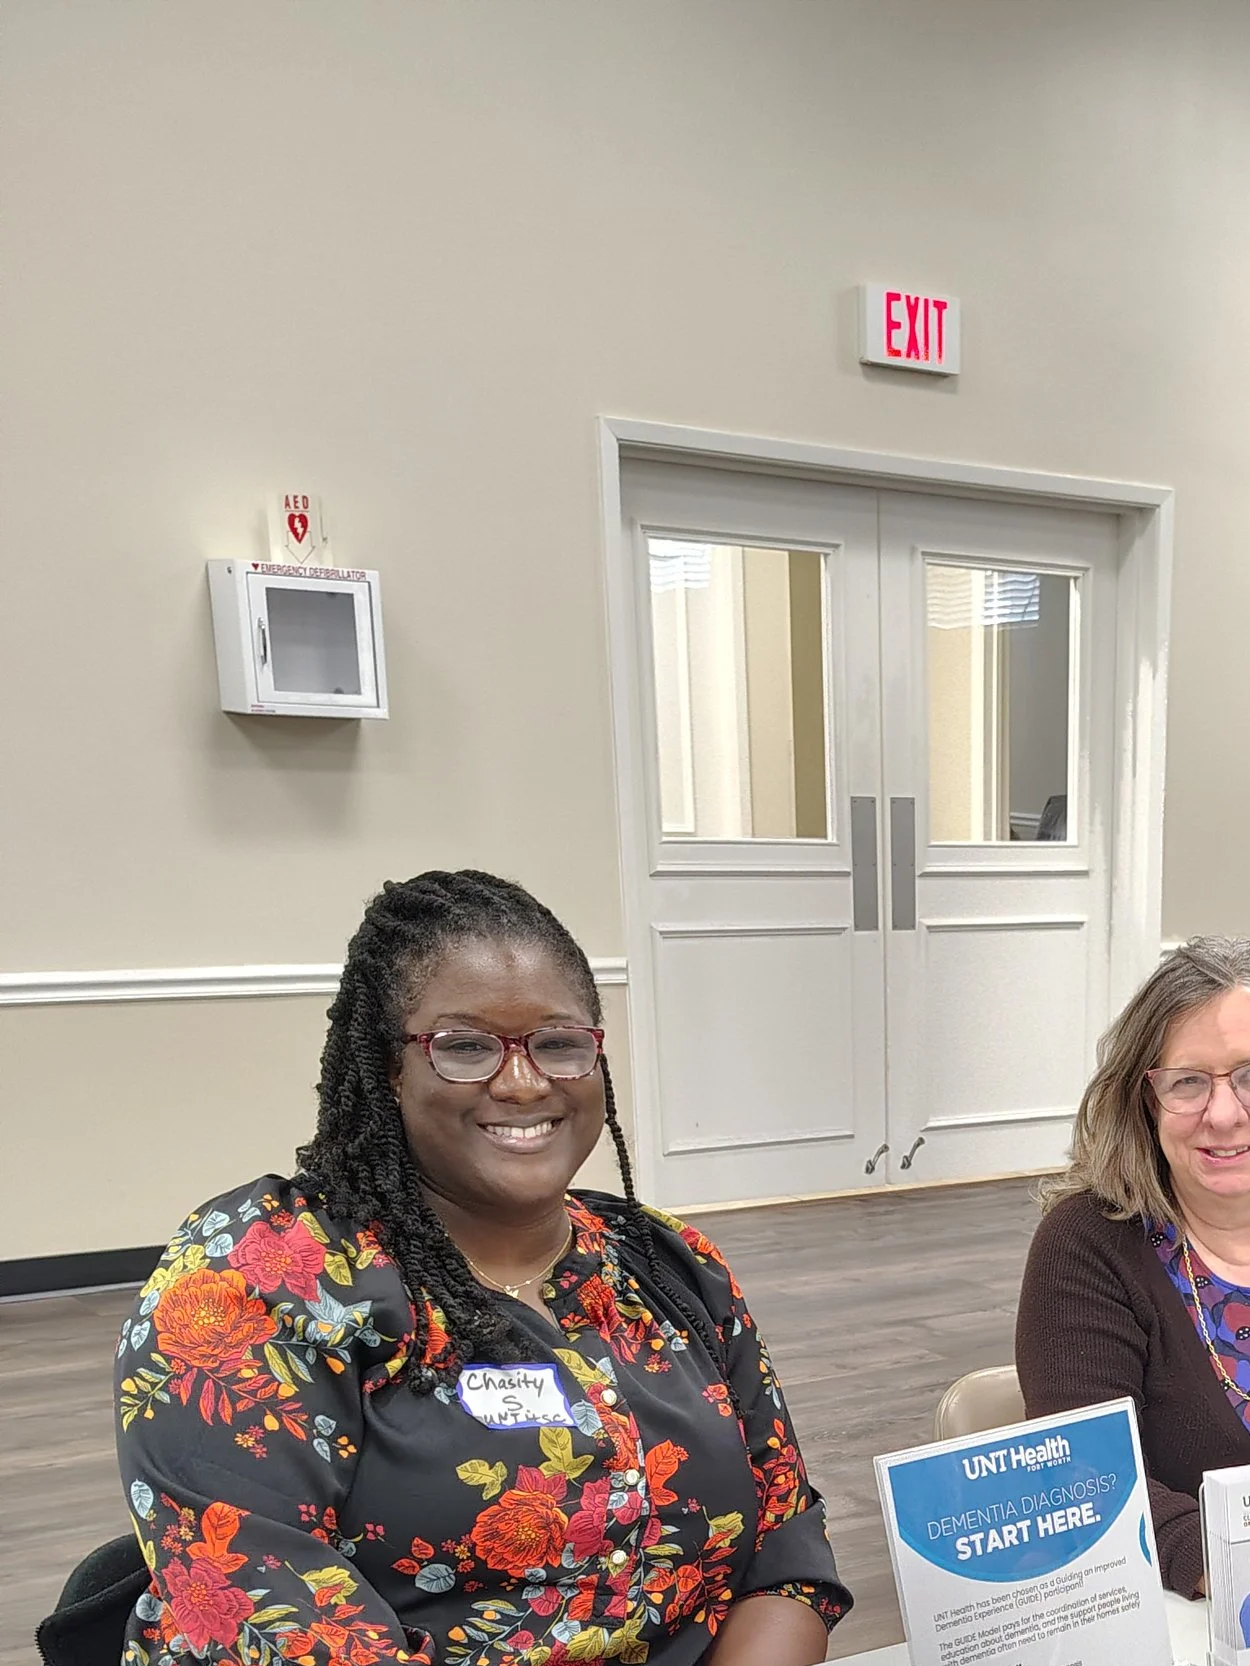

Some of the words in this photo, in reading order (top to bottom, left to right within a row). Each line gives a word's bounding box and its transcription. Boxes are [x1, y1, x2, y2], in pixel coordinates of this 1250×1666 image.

[885, 290, 948, 364] EXIT
[284, 494, 309, 510] AED
[261, 564, 308, 577] EMERGENCY
[309, 567, 366, 580] DEFIBRILLATOR
[466, 1372, 544, 1398] Chasity
[502, 1395, 524, 1411] S
[962, 1449, 1008, 1480] UNT
[1010, 1435, 1070, 1469] Health
[1027, 1462, 1046, 1472] FORT
[1047, 1456, 1071, 1468] WORTH
[927, 1502, 1018, 1540] DEMENTIA
[1020, 1473, 1117, 1514] DIAGNOSIS?
[955, 1519, 1032, 1561] START
[1037, 1501, 1101, 1538] HERE.
[933, 1610, 949, 1621] UNT
[950, 1602, 974, 1617] Health
[976, 1599, 990, 1609] has
[991, 1593, 1010, 1604] been
[1012, 1585, 1038, 1598] chosen
[1056, 1571, 1083, 1585] Guiding
[1094, 1556, 1126, 1573] Improved
[935, 1614, 972, 1631] Dementia
[974, 1602, 1013, 1619] Experience
[1015, 1592, 1042, 1609] (GUIDE)
[1044, 1579, 1084, 1600] participant!
[939, 1640, 953, 1650] The
[954, 1631, 976, 1645] GUIDE
[978, 1624, 1000, 1638] Model
[1002, 1620, 1020, 1633] pays
[1021, 1616, 1030, 1625] for
[1032, 1612, 1044, 1621] the
[1046, 1599, 1089, 1617] coordination
[1099, 1588, 1126, 1601] services,
